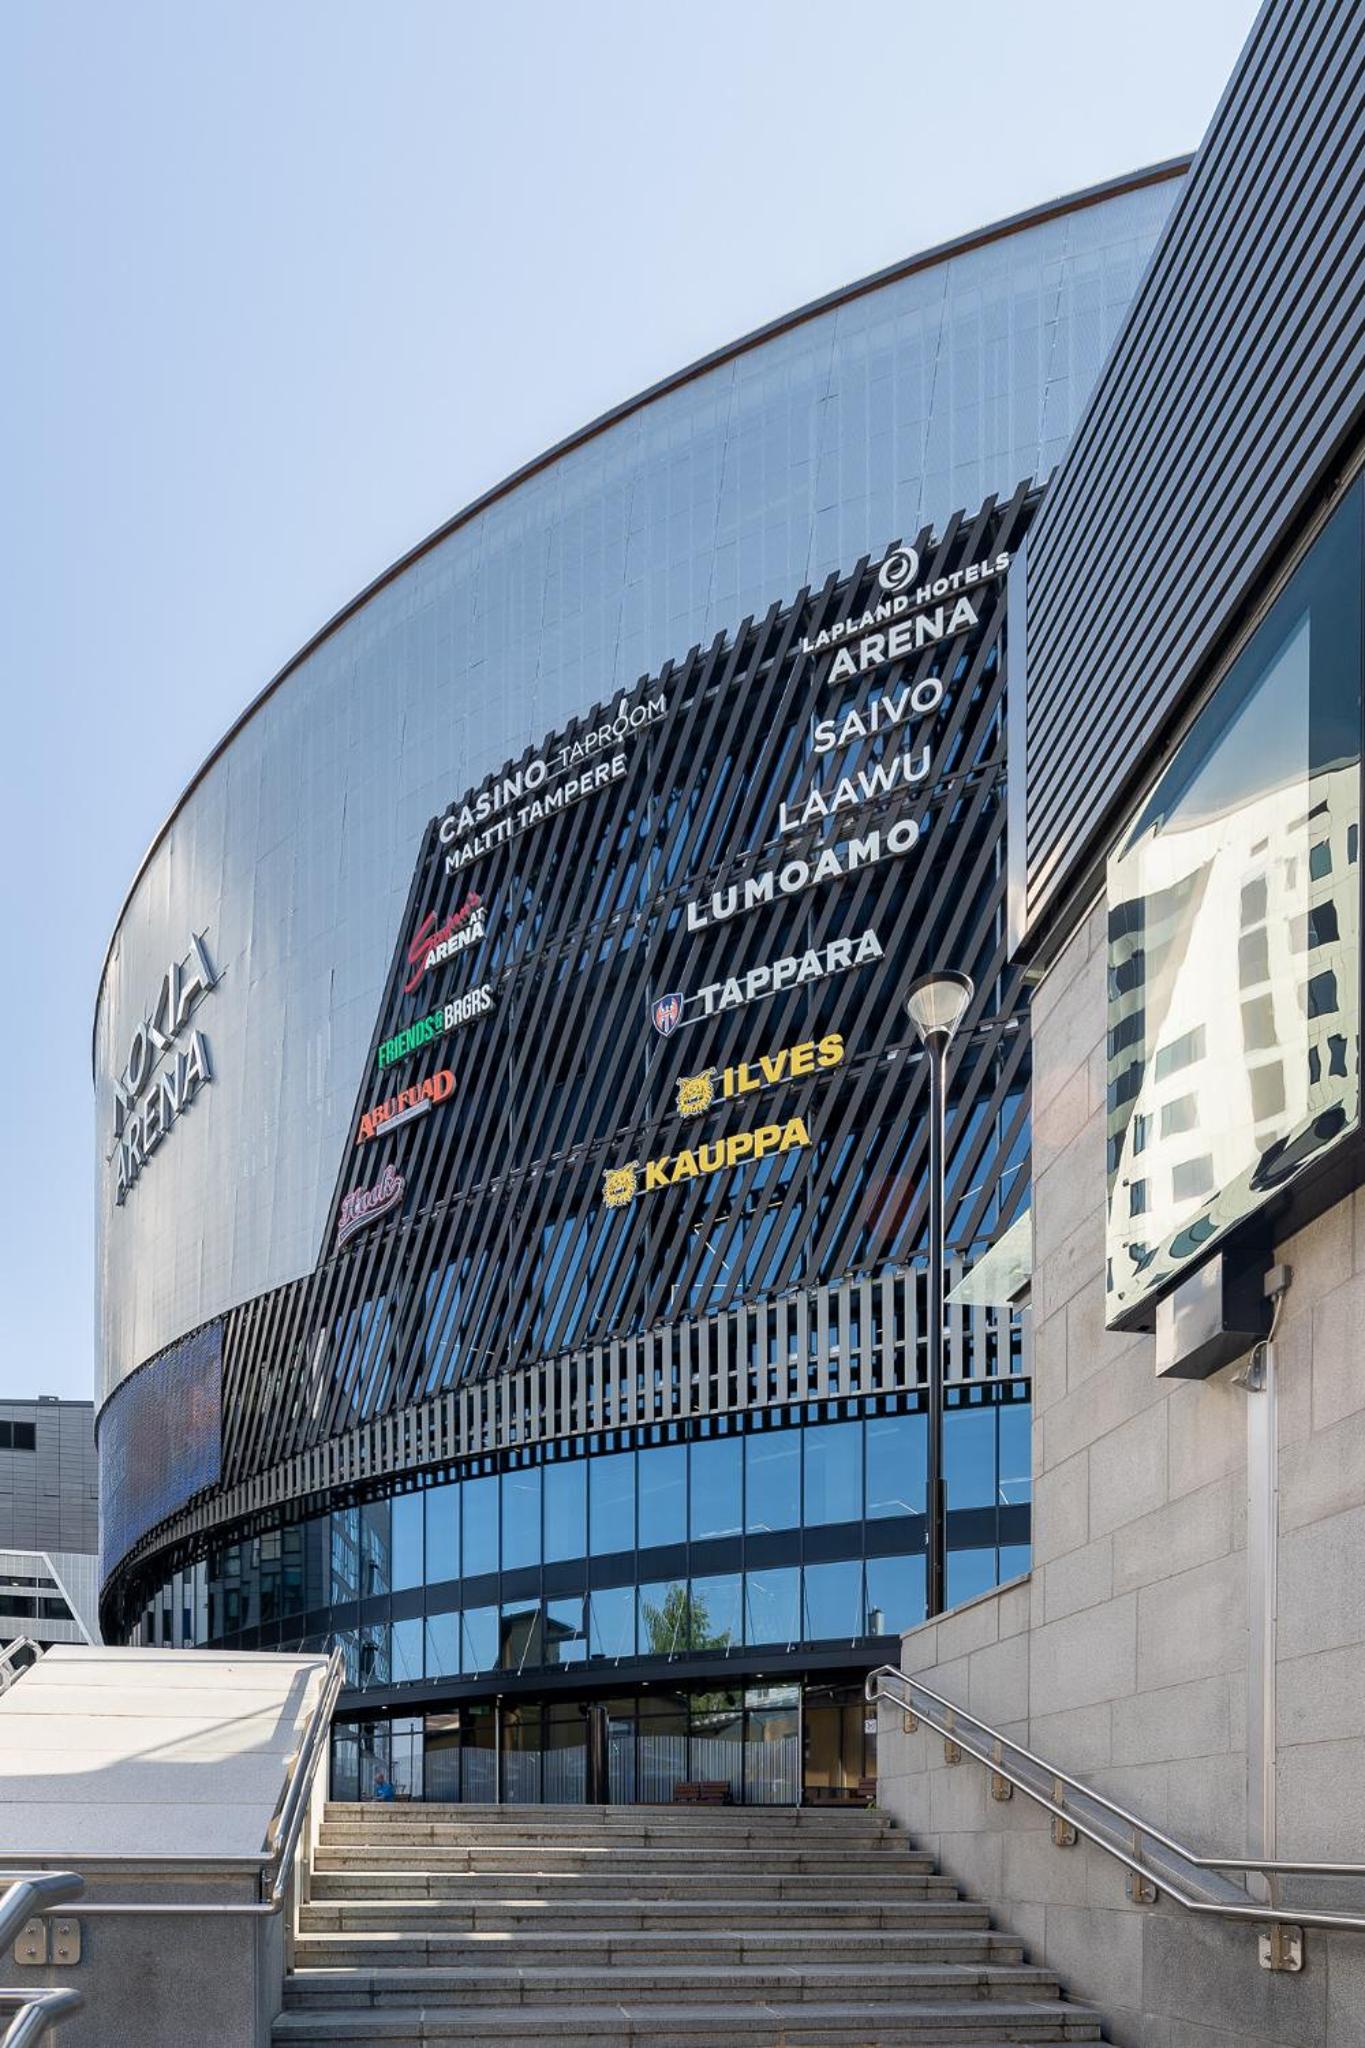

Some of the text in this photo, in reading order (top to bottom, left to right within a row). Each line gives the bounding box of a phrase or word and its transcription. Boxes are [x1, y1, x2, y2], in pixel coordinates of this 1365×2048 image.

[803, 552, 1010, 653] LAPLAND HOTELS
[828, 597, 979, 684] ARENA
[814, 677, 944, 754] SAIVO
[439, 695, 666, 844] CASINO TAPROOM
[779, 746, 931, 833] LAAWU
[445, 754, 625, 874] MALTTI TAMPERE
[687, 818, 919, 932] LUMOAMO
[424, 921, 486, 970] ARENA
[698, 929, 883, 1015] TAPPARA
[723, 1034, 845, 1098] ILVES
[116, 1029, 211, 1206] ARENA
[645, 1117, 810, 1191] KAUPPA
